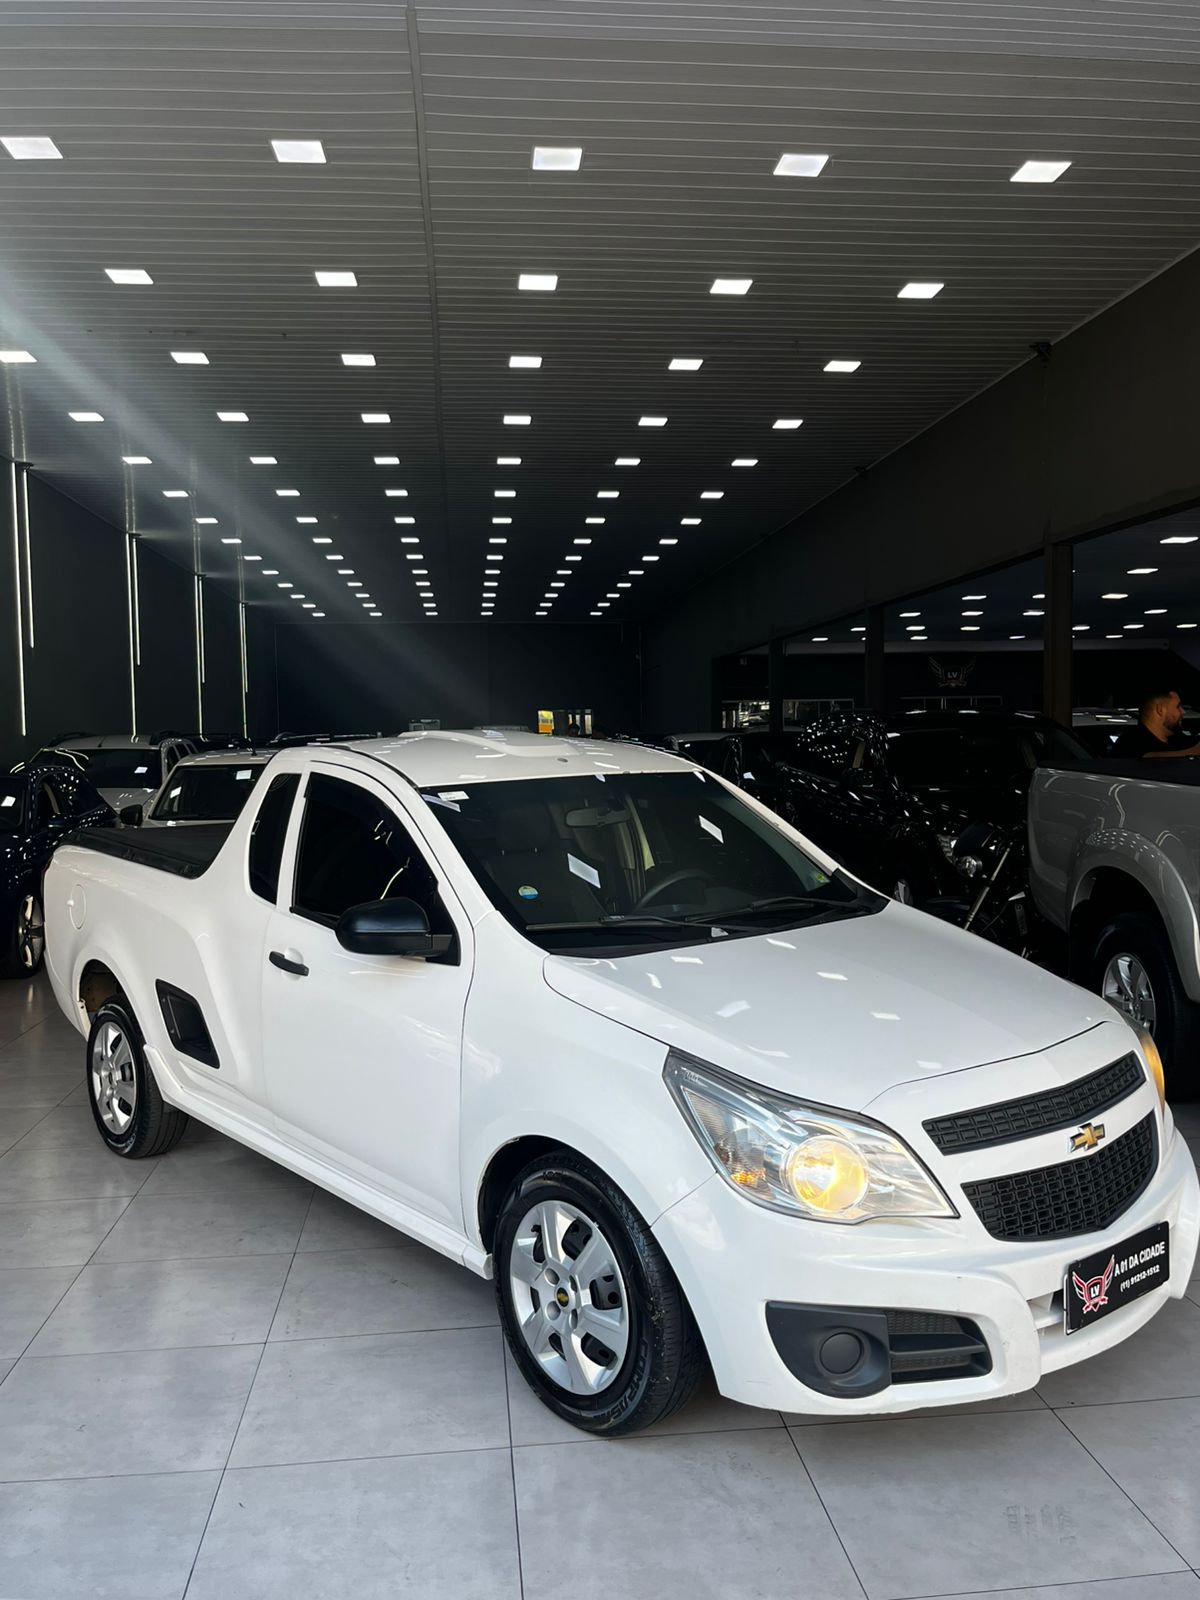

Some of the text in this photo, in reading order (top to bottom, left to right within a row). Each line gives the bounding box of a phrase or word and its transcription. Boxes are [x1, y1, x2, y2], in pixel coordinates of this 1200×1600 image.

[1114, 1241, 1166, 1277] A 01 DA CIDADE
[1090, 1284, 1100, 1298] LV
[1120, 1279, 1130, 1293] (11)
